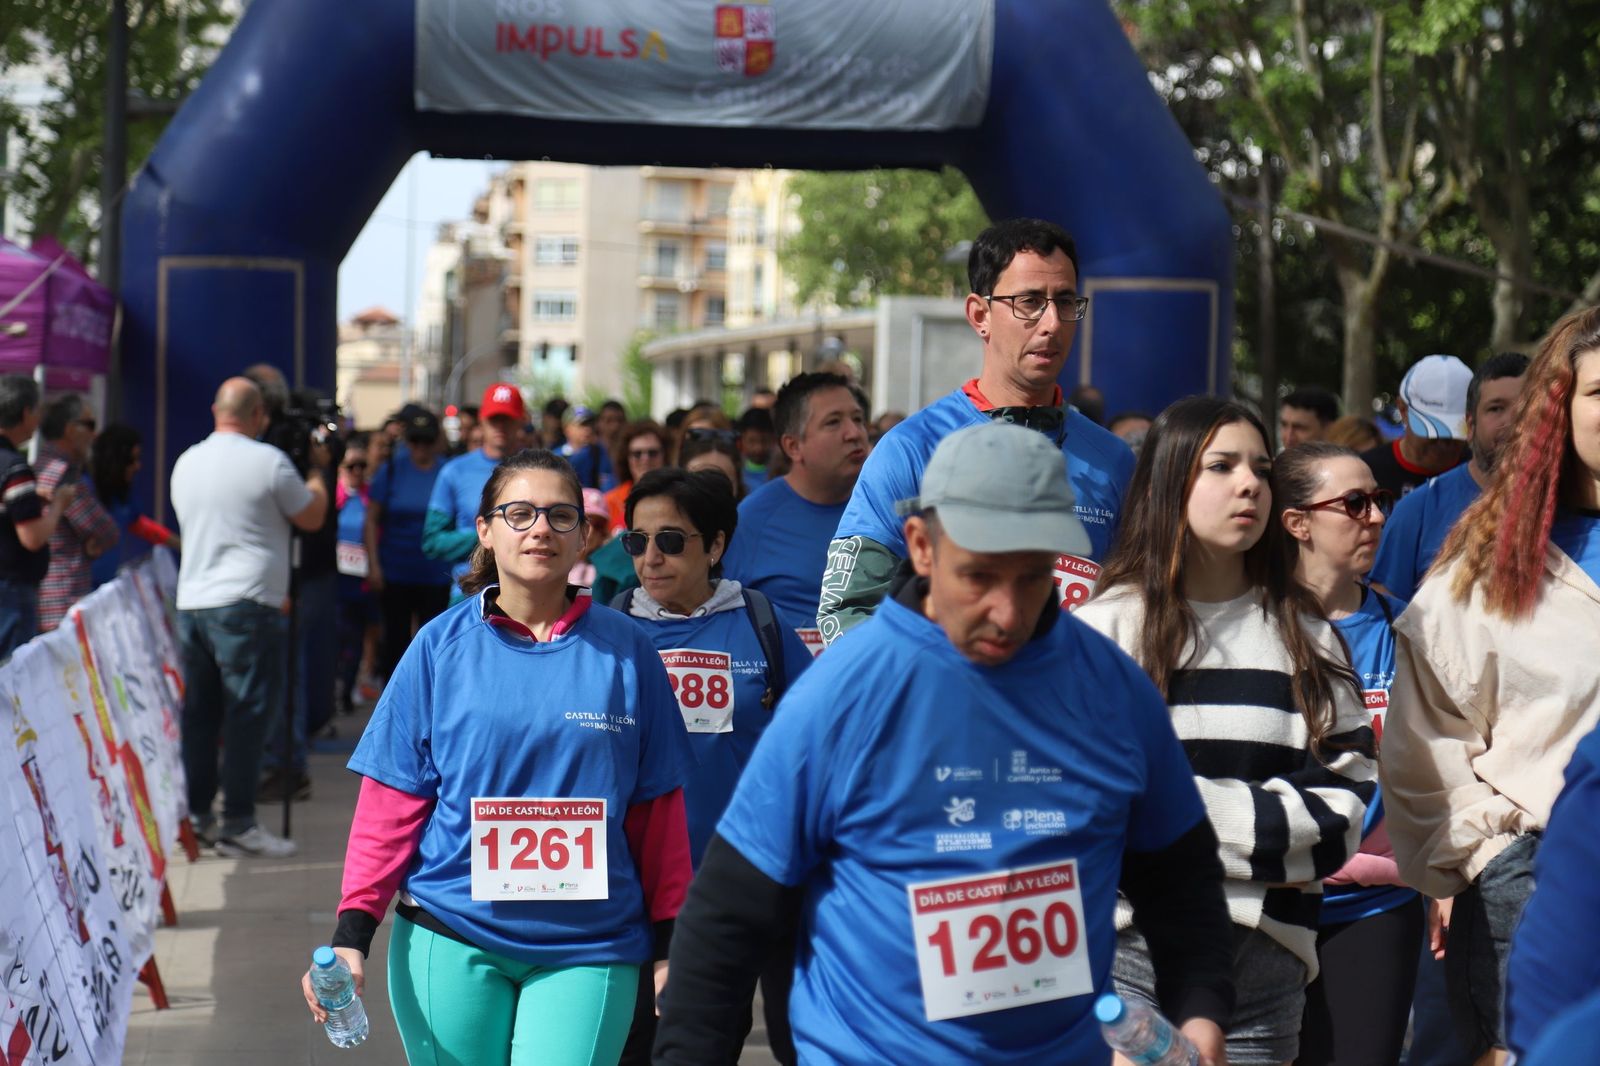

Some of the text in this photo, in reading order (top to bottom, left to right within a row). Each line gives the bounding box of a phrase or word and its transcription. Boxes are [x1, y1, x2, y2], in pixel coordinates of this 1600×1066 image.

[496, 0, 564, 17] NOS
[495, 21, 669, 63] IMPULSA
[1064, 559, 1071, 567] Y
[1072, 561, 1098, 575] LEÓN
[662, 656, 698, 664] CASTILLA
[705, 656, 726, 666] LEÓN
[1364, 694, 1384, 704] EÓN
[564, 712, 636, 726] CASTILLA Y LEÓN
[594, 722, 622, 733] IMPULSA
[1008, 775, 1035, 783] Castilla
[1042, 774, 1062, 783] León
[478, 804, 600, 816] DÍA DE CASTILLA Y LEÓN
[1024, 809, 1066, 822] Plena
[1026, 821, 1066, 830] inclusión
[480, 828, 594, 870] 1261
[920, 872, 1070, 908] DÍA DE CASTILLA Y LEÓN
[928, 901, 1079, 978] 1260
